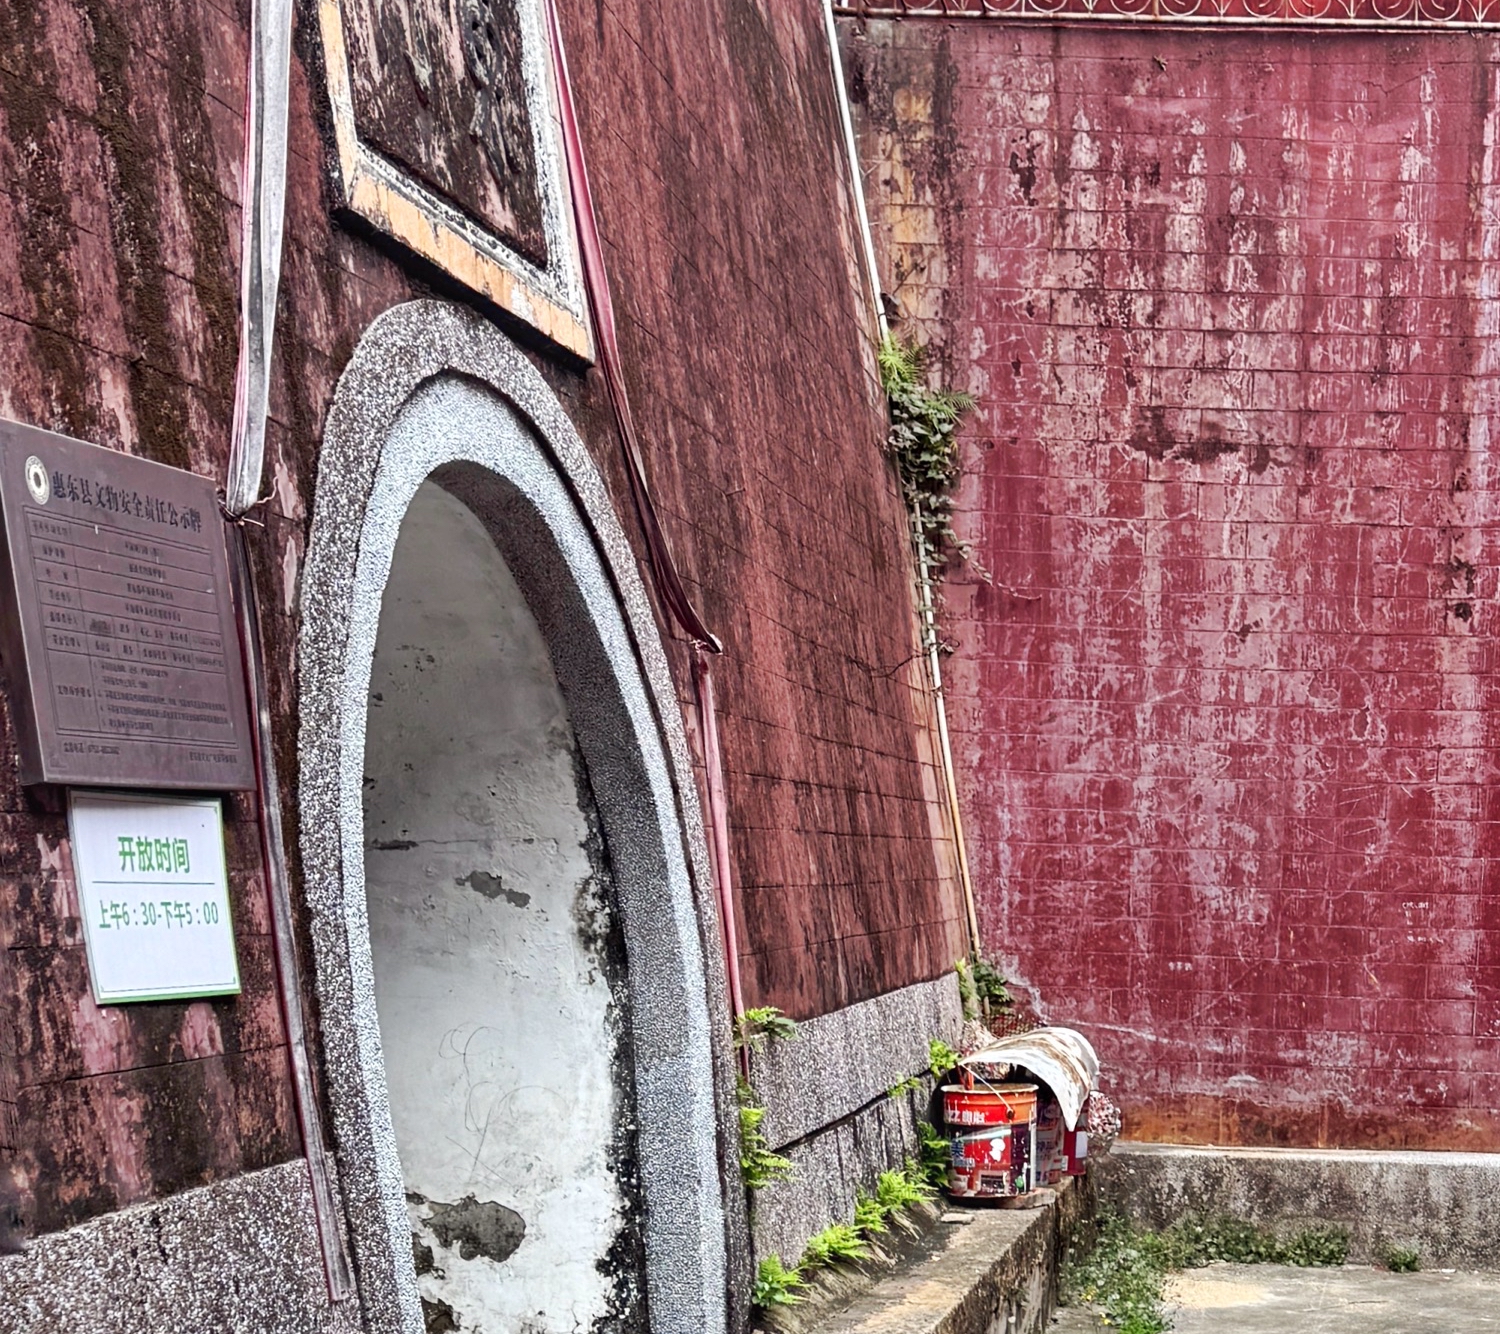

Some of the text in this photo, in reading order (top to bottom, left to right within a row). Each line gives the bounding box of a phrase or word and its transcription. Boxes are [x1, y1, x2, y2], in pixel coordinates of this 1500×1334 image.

[52, 470, 202, 533] 惠东县文物安全责任公示牌
[117, 835, 190, 874] 开放时间
